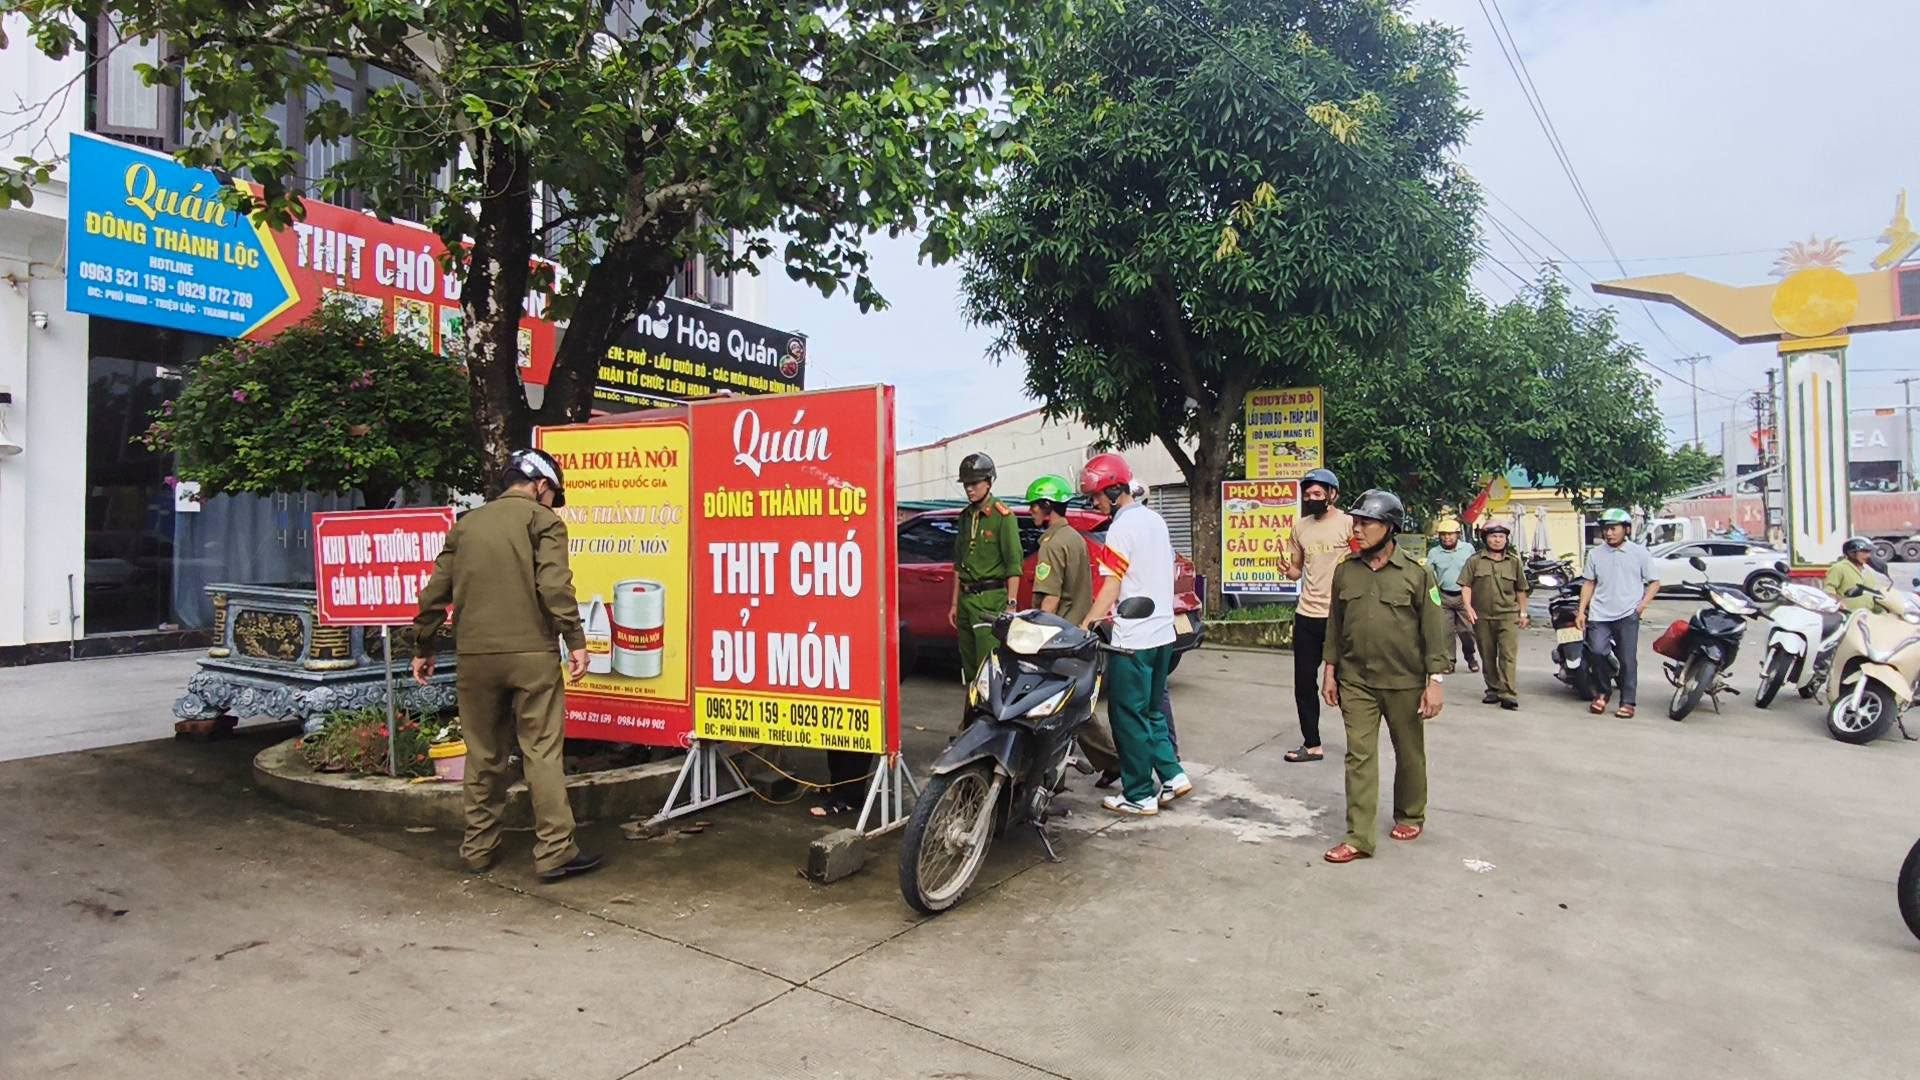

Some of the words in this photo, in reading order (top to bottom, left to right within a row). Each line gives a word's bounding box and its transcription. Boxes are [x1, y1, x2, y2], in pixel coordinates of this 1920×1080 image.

[124, 162, 228, 228] Quán
[149, 256, 194, 276] HOTLINE
[153, 227, 219, 261] THÀNH
[224, 241, 259, 270] LỘC
[293, 221, 365, 287] THỊT
[375, 243, 435, 296] CHÓ
[79, 261, 113, 283] 0963
[116, 267, 139, 288] 521
[143, 273, 166, 292] 159
[177, 280, 206, 300] 0929
[209, 286, 230, 304] 872
[232, 290, 253, 309] 789
[677, 313, 720, 353] Hòa
[727, 329, 778, 368] Quán
[1252, 392, 1296, 406] CHUYÊN
[732, 408, 832, 478] Quán
[1851, 430, 1889, 448] EA
[581, 451, 613, 470] HƠI
[616, 446, 642, 469] HÀ
[644, 445, 679, 472] NỘI
[621, 474, 649, 489] QUỐC
[651, 478, 668, 488] GIA
[1228, 482, 1259, 498] PHỞ
[1260, 482, 1293, 498] HÒA
[592, 501, 647, 525] THÀNH
[649, 503, 682, 529] LỘC
[758, 483, 822, 518] THÀNH
[828, 481, 867, 522] LỘC
[1259, 514, 1294, 532] NẠM
[322, 535, 346, 565] KHU
[347, 530, 372, 570] VỰC
[373, 527, 420, 564] TRƯỜNG
[588, 534, 614, 553] CHÓ
[638, 534, 669, 554] MÓN
[331, 566, 357, 606] CẤM
[402, 574, 418, 604] XE
[708, 542, 780, 607] THỊT
[790, 529, 862, 598] CHÓ
[711, 607, 756, 684] ĐỦ
[767, 621, 850, 691] MÓN
[706, 697, 732, 720] 0963
[735, 700, 754, 721] 521
[759, 701, 779, 724] 159
[790, 703, 818, 727] 0929
[822, 706, 843, 730] 872
[849, 708, 869, 732] 789
[739, 726, 760, 739] NINH
[820, 733, 850, 747] THANH
